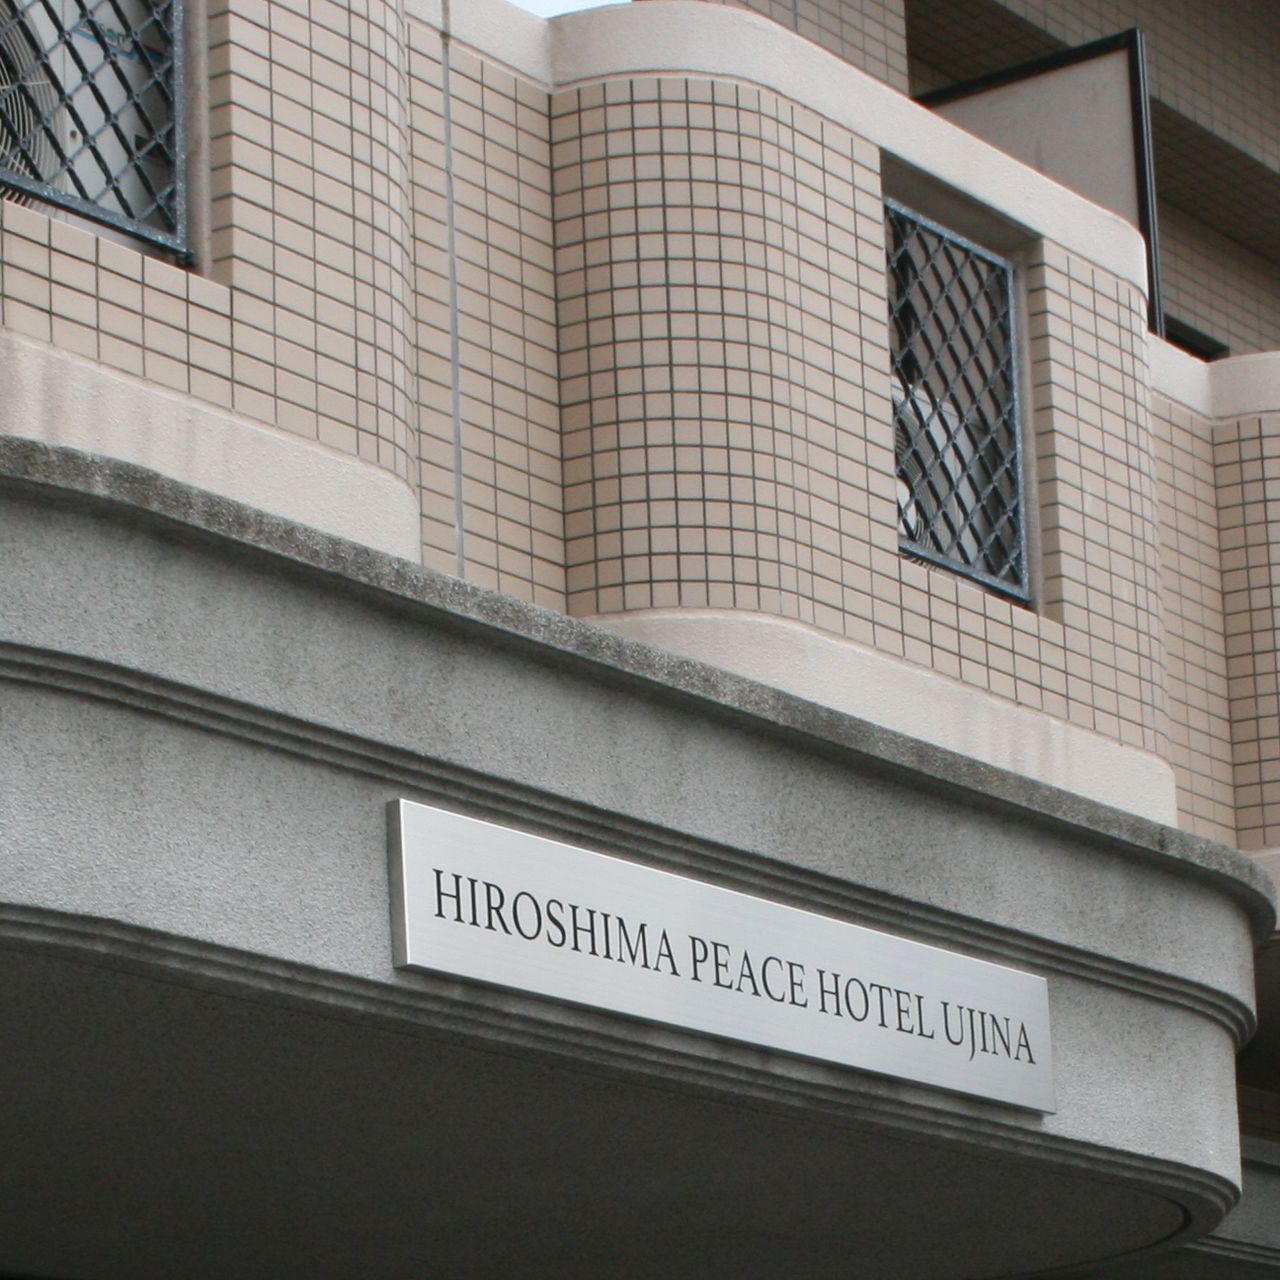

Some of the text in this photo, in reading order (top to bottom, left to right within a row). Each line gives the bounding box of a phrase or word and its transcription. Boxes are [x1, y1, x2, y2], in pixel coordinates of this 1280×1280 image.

[432, 868, 1036, 1063] HIROSHIMA PEACE HOTEL UJINA
